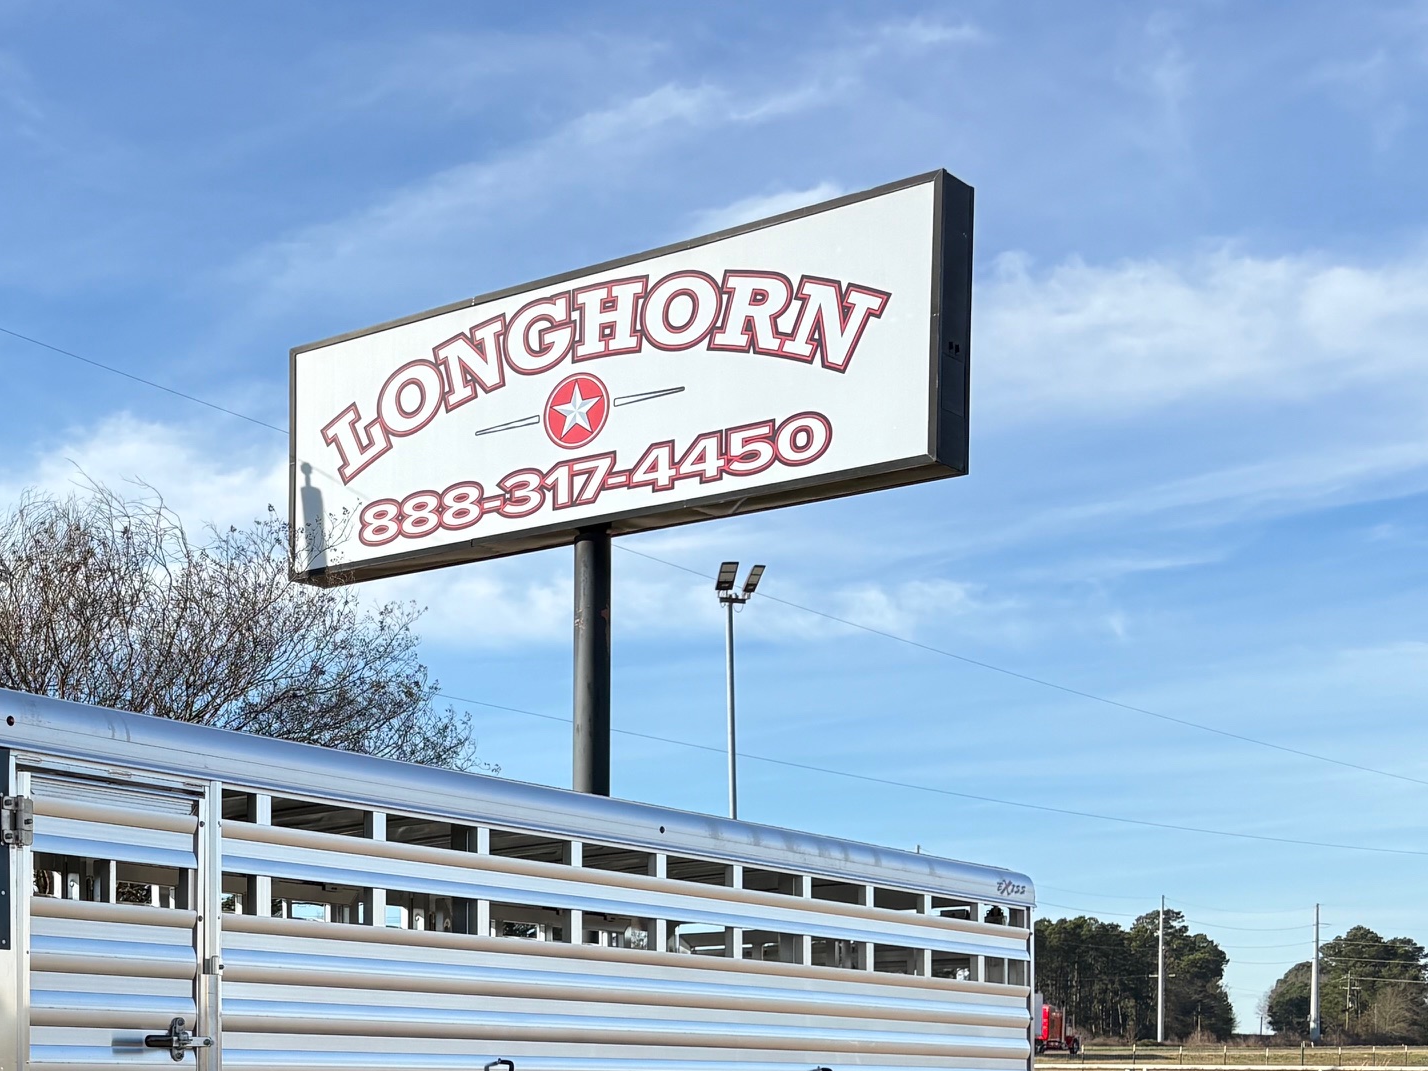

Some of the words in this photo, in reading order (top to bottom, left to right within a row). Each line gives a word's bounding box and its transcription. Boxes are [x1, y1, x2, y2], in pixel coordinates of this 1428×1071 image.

[321, 269, 892, 485] LONGHORN
[358, 411, 833, 548] 888-317-4450
[997, 880, 1026, 895] EXISS
